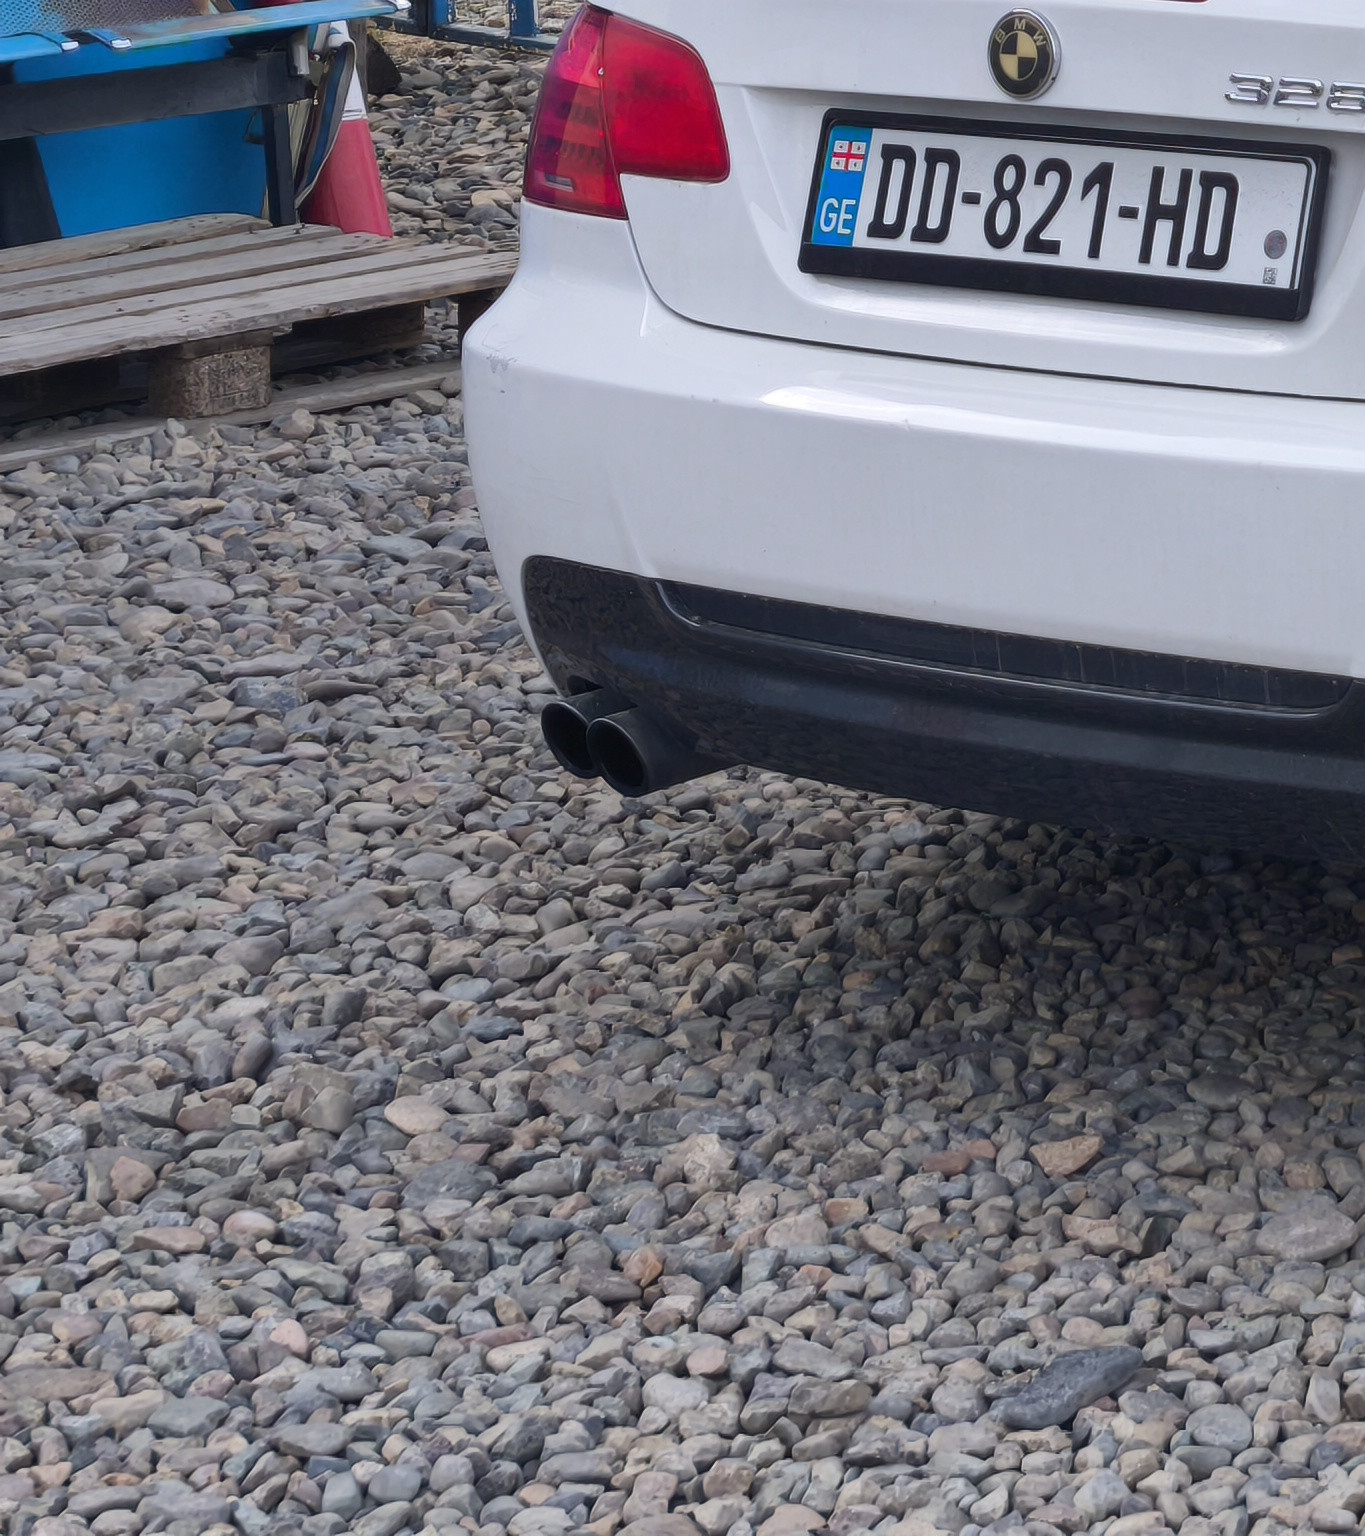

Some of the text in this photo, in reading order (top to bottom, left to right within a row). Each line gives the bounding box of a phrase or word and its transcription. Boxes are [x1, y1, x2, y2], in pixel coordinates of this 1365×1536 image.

[994, 18, 1047, 46] BMW
[820, 198, 857, 237] GE
[867, 144, 1240, 270] DD-821-HD
